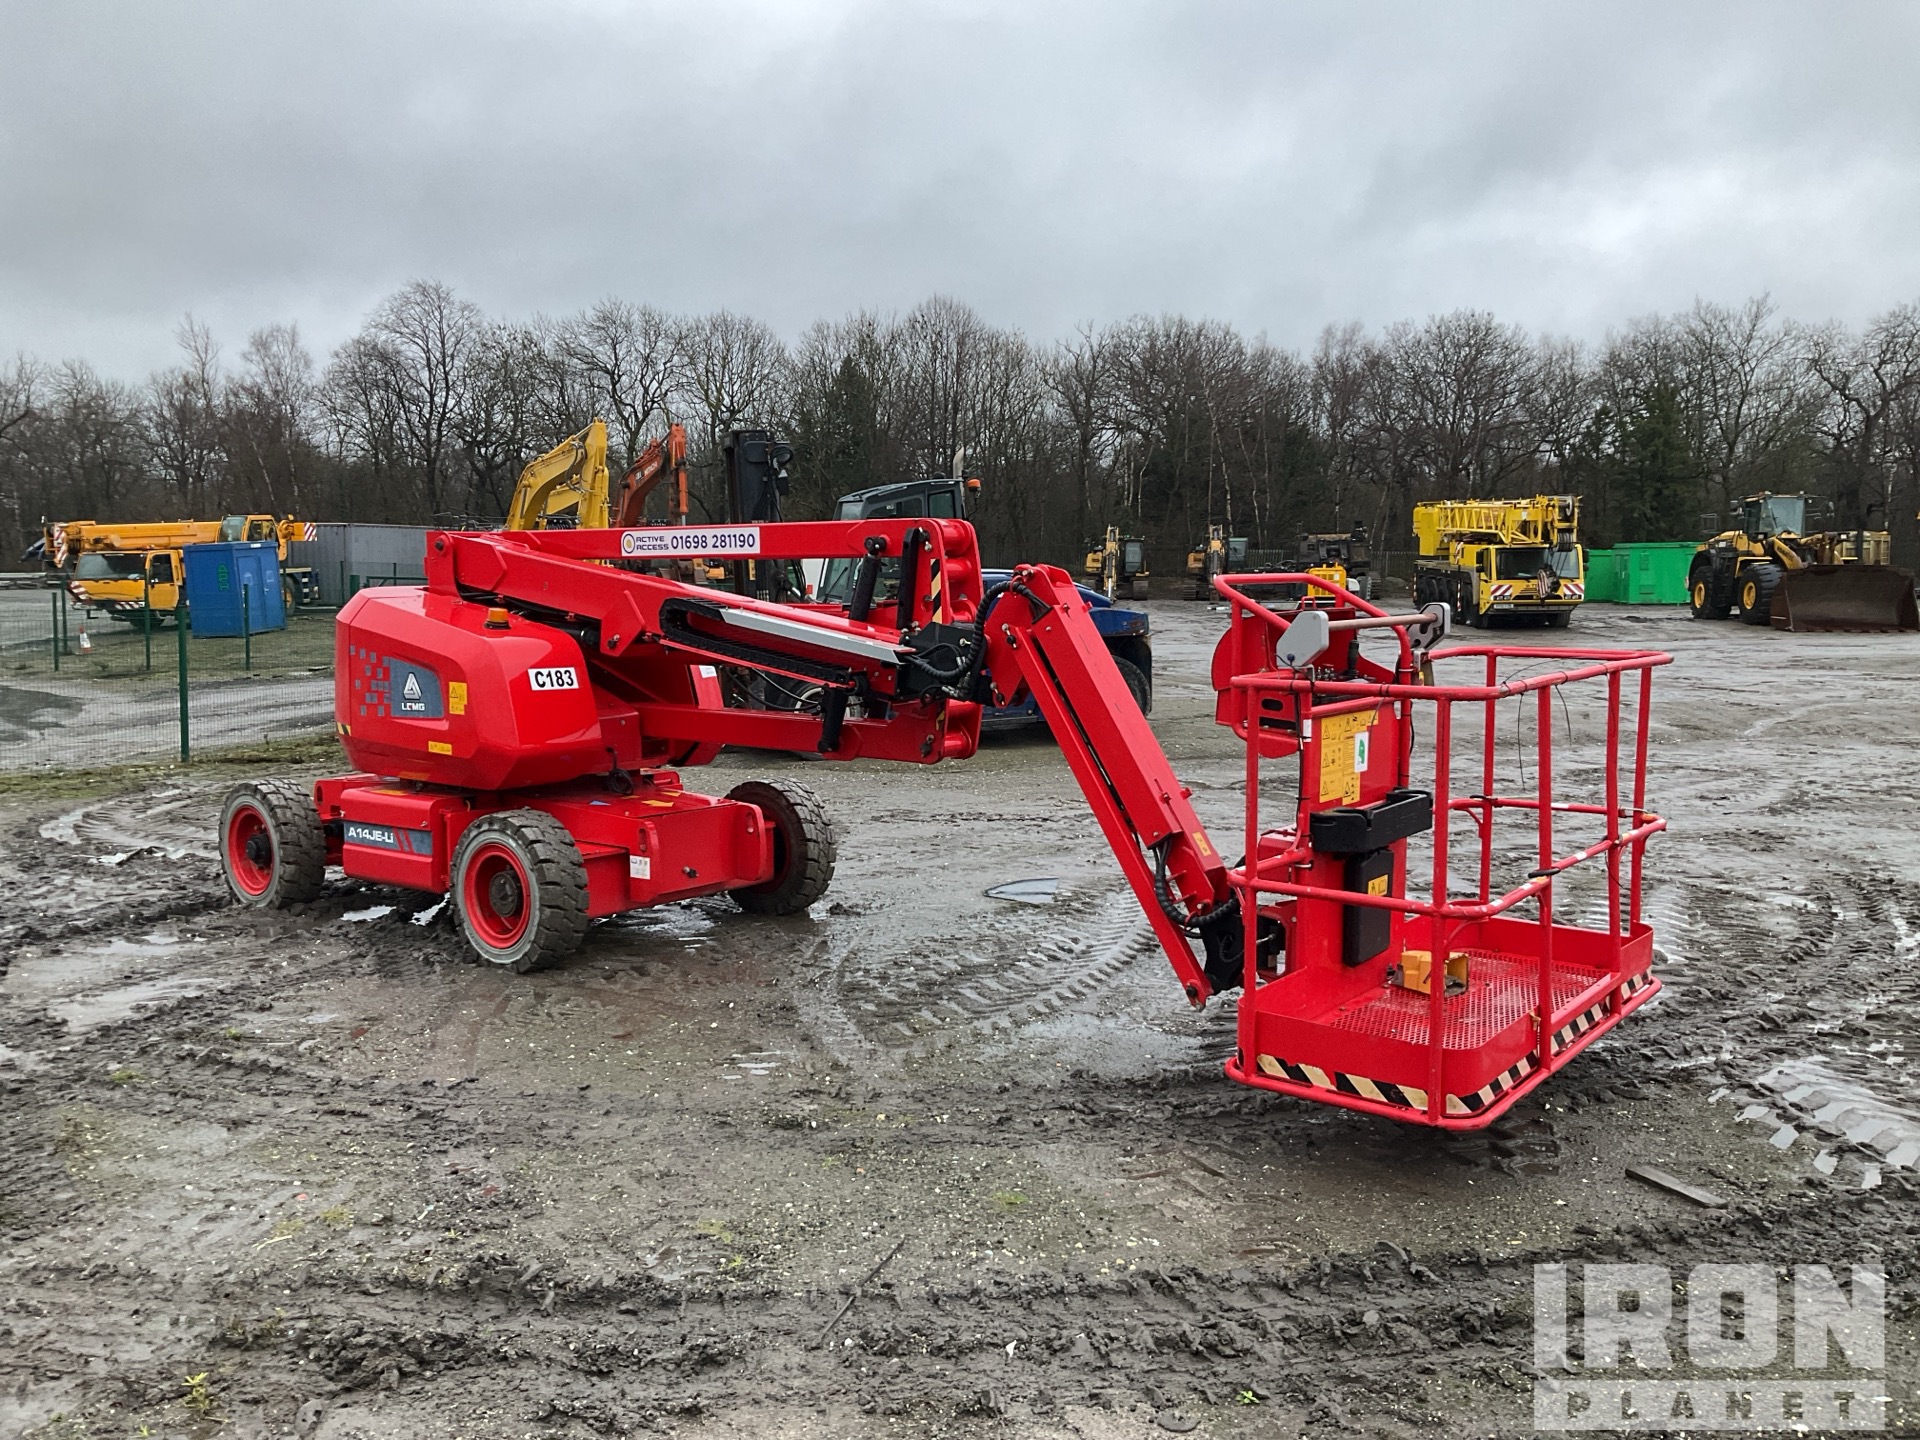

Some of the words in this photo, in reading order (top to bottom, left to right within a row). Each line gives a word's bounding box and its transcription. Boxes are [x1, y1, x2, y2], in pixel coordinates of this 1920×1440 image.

[635, 535, 665, 543] ACTIVE
[671, 535, 707, 549] 01698
[712, 534, 755, 548] 281190
[635, 543, 669, 551] ACCESS
[535, 670, 574, 688] C183
[348, 826, 394, 843] A14JE-Li
